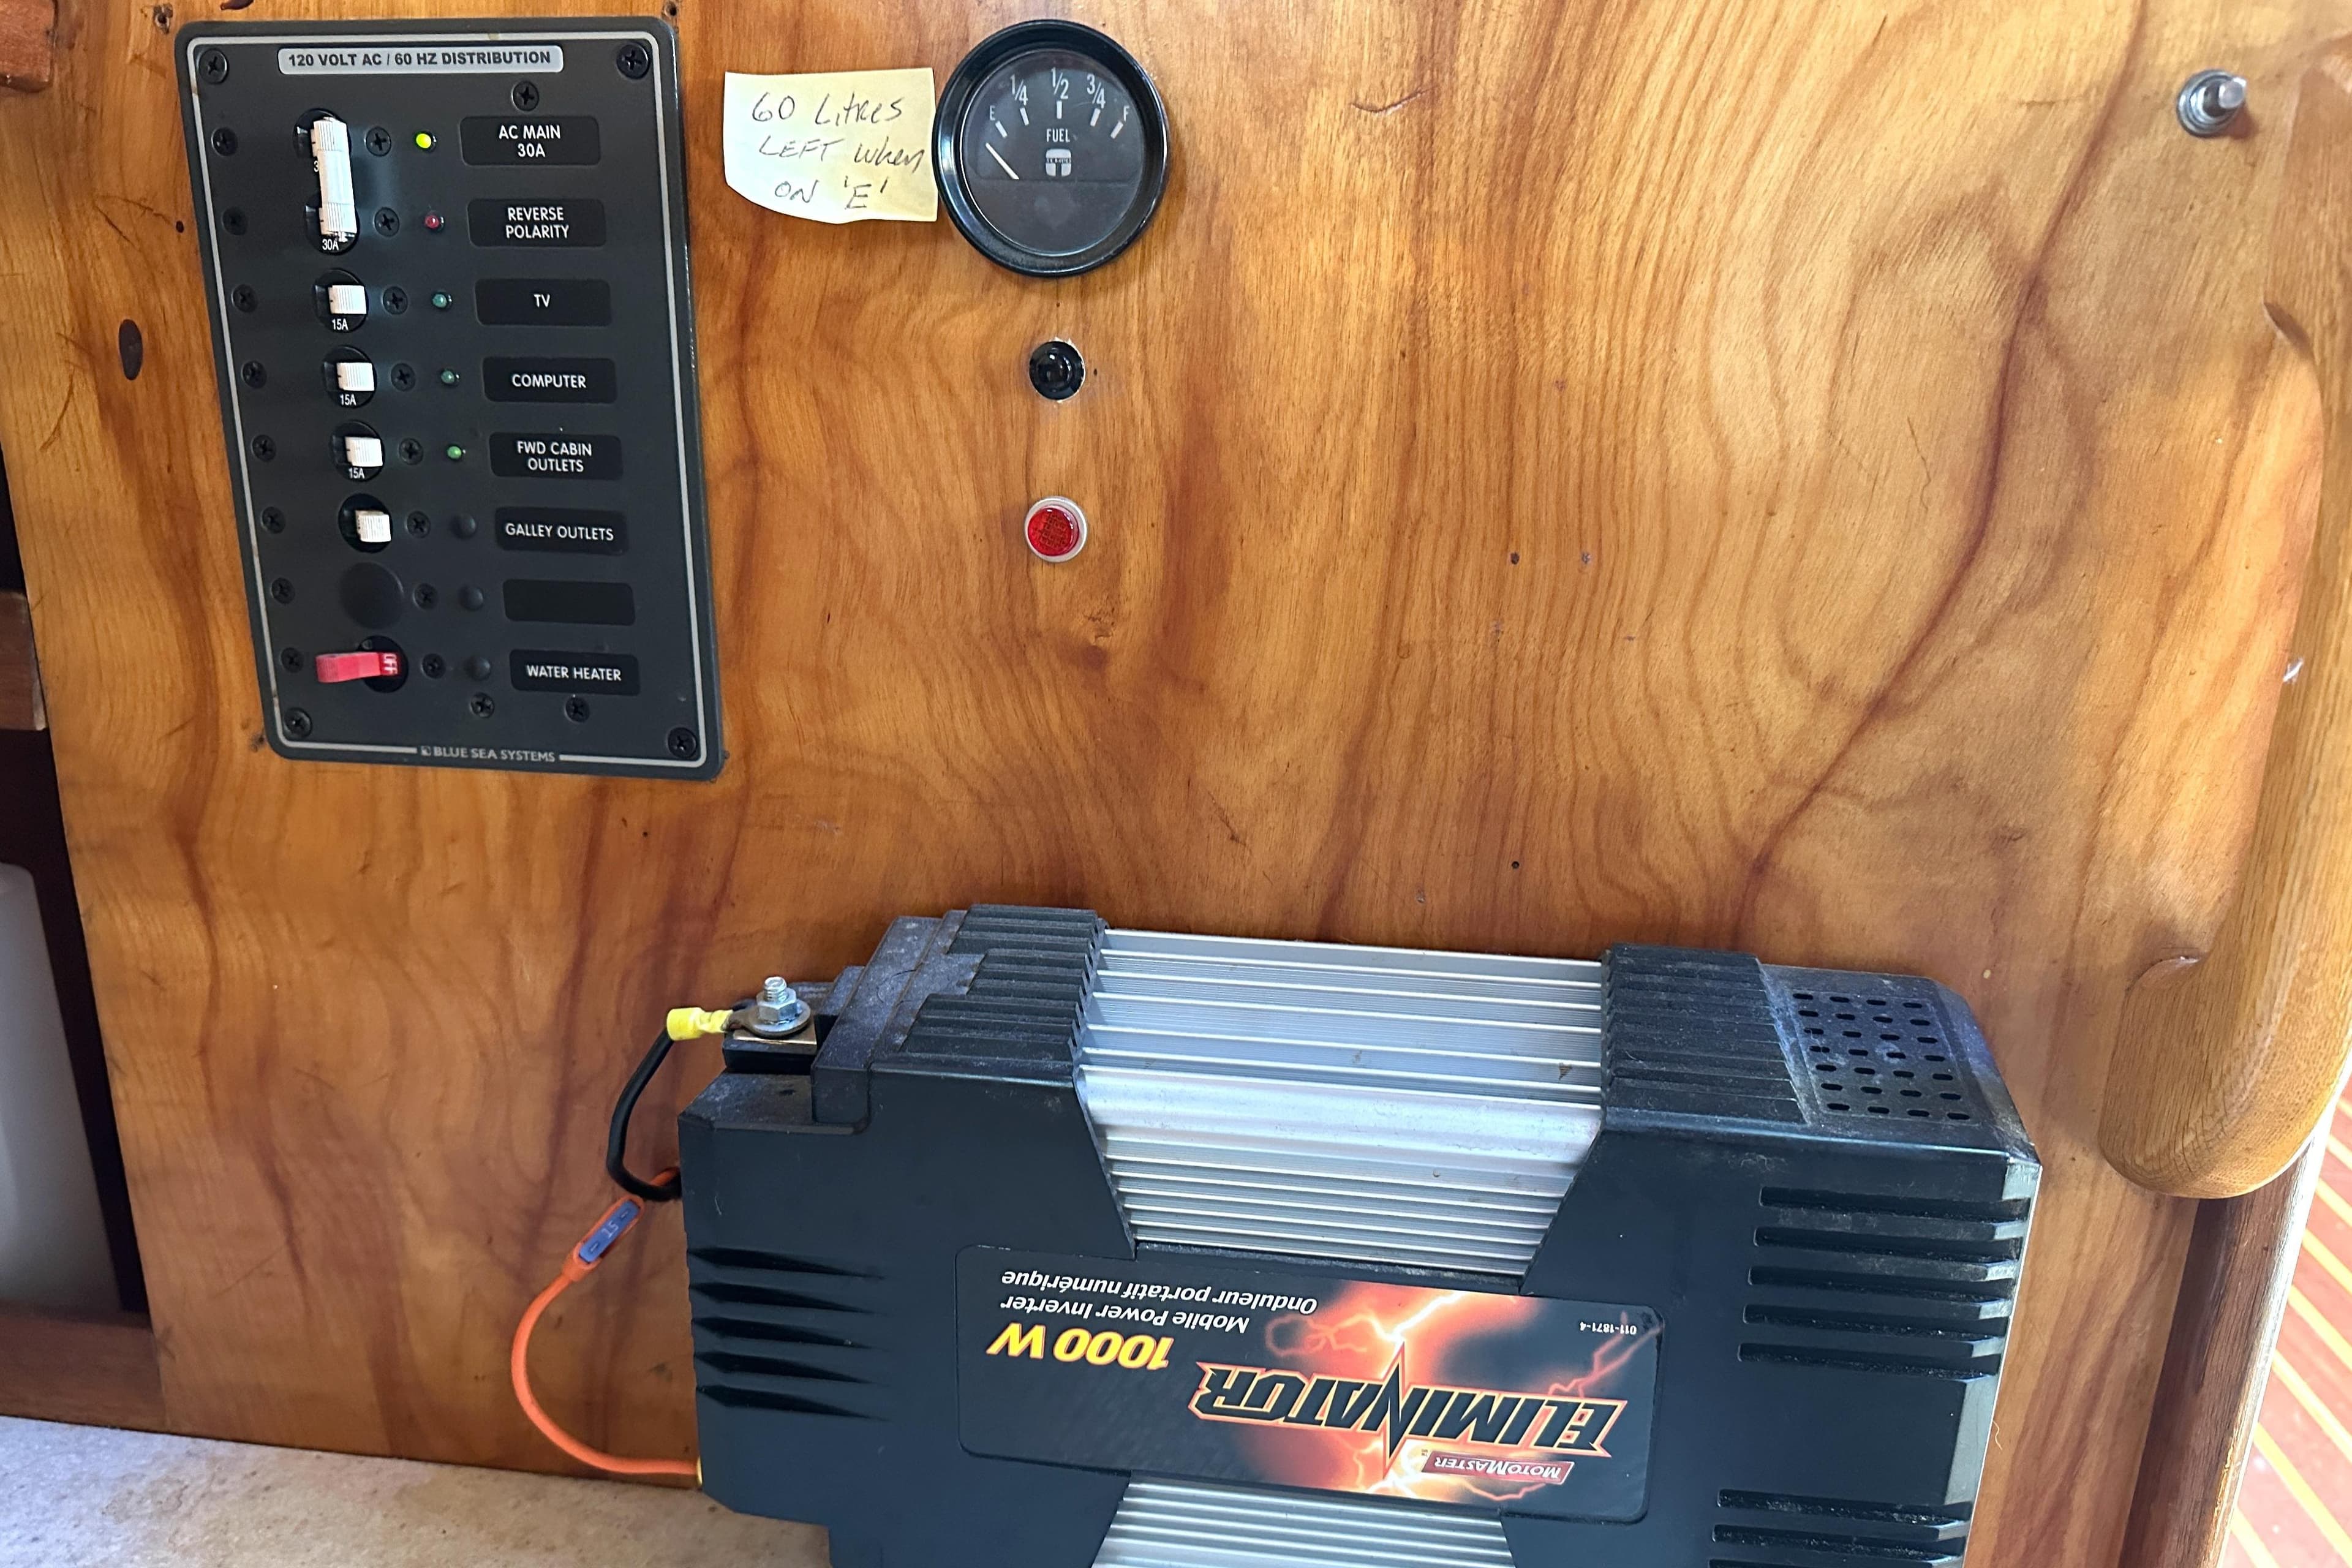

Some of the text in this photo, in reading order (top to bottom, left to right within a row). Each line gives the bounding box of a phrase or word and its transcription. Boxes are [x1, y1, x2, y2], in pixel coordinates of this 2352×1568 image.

[289, 51, 551, 67] 120 VOLT AC / 60 HZ DISTRIBUTION
[752, 92, 795, 122] 60
[989, 106, 995, 121] E
[1123, 106, 1130, 121] F
[499, 125, 561, 140] AC MAIN
[1046, 128, 1071, 143] FUEL
[518, 143, 546, 158] 30A
[759, 135, 846, 162] LEFT
[508, 207, 564, 221] REVERSE
[505, 225, 570, 239] POLARITY
[322, 238, 339, 251] 30A
[533, 294, 551, 307] TV
[332, 318, 349, 331] 15A
[512, 375, 587, 389] COMPUTER
[340, 394, 356, 406] 15A
[518, 442, 592, 456] FWD CABIN
[527, 458, 584, 473] OUTLETS
[349, 467, 364, 480] 15A
[505, 522, 614, 541] GALLEY OUTLETS
[383, 654, 398, 675] OFF
[527, 665, 622, 682] WATER HEATER
[433, 746, 556, 762] BLUE SEA SYSTEMS
[601, 1220, 619, 1238] 15
[1001, 1270, 1317, 1315] Onduleur portatif numérique
[1000, 1296, 1250, 1334] Mobile Power Inverter
[1580, 1322, 1637, 1336] 011-1871-4
[986, 1322, 1175, 1371] 1000 W
[1188, 1343, 1628, 1476] ELIMINATOR
